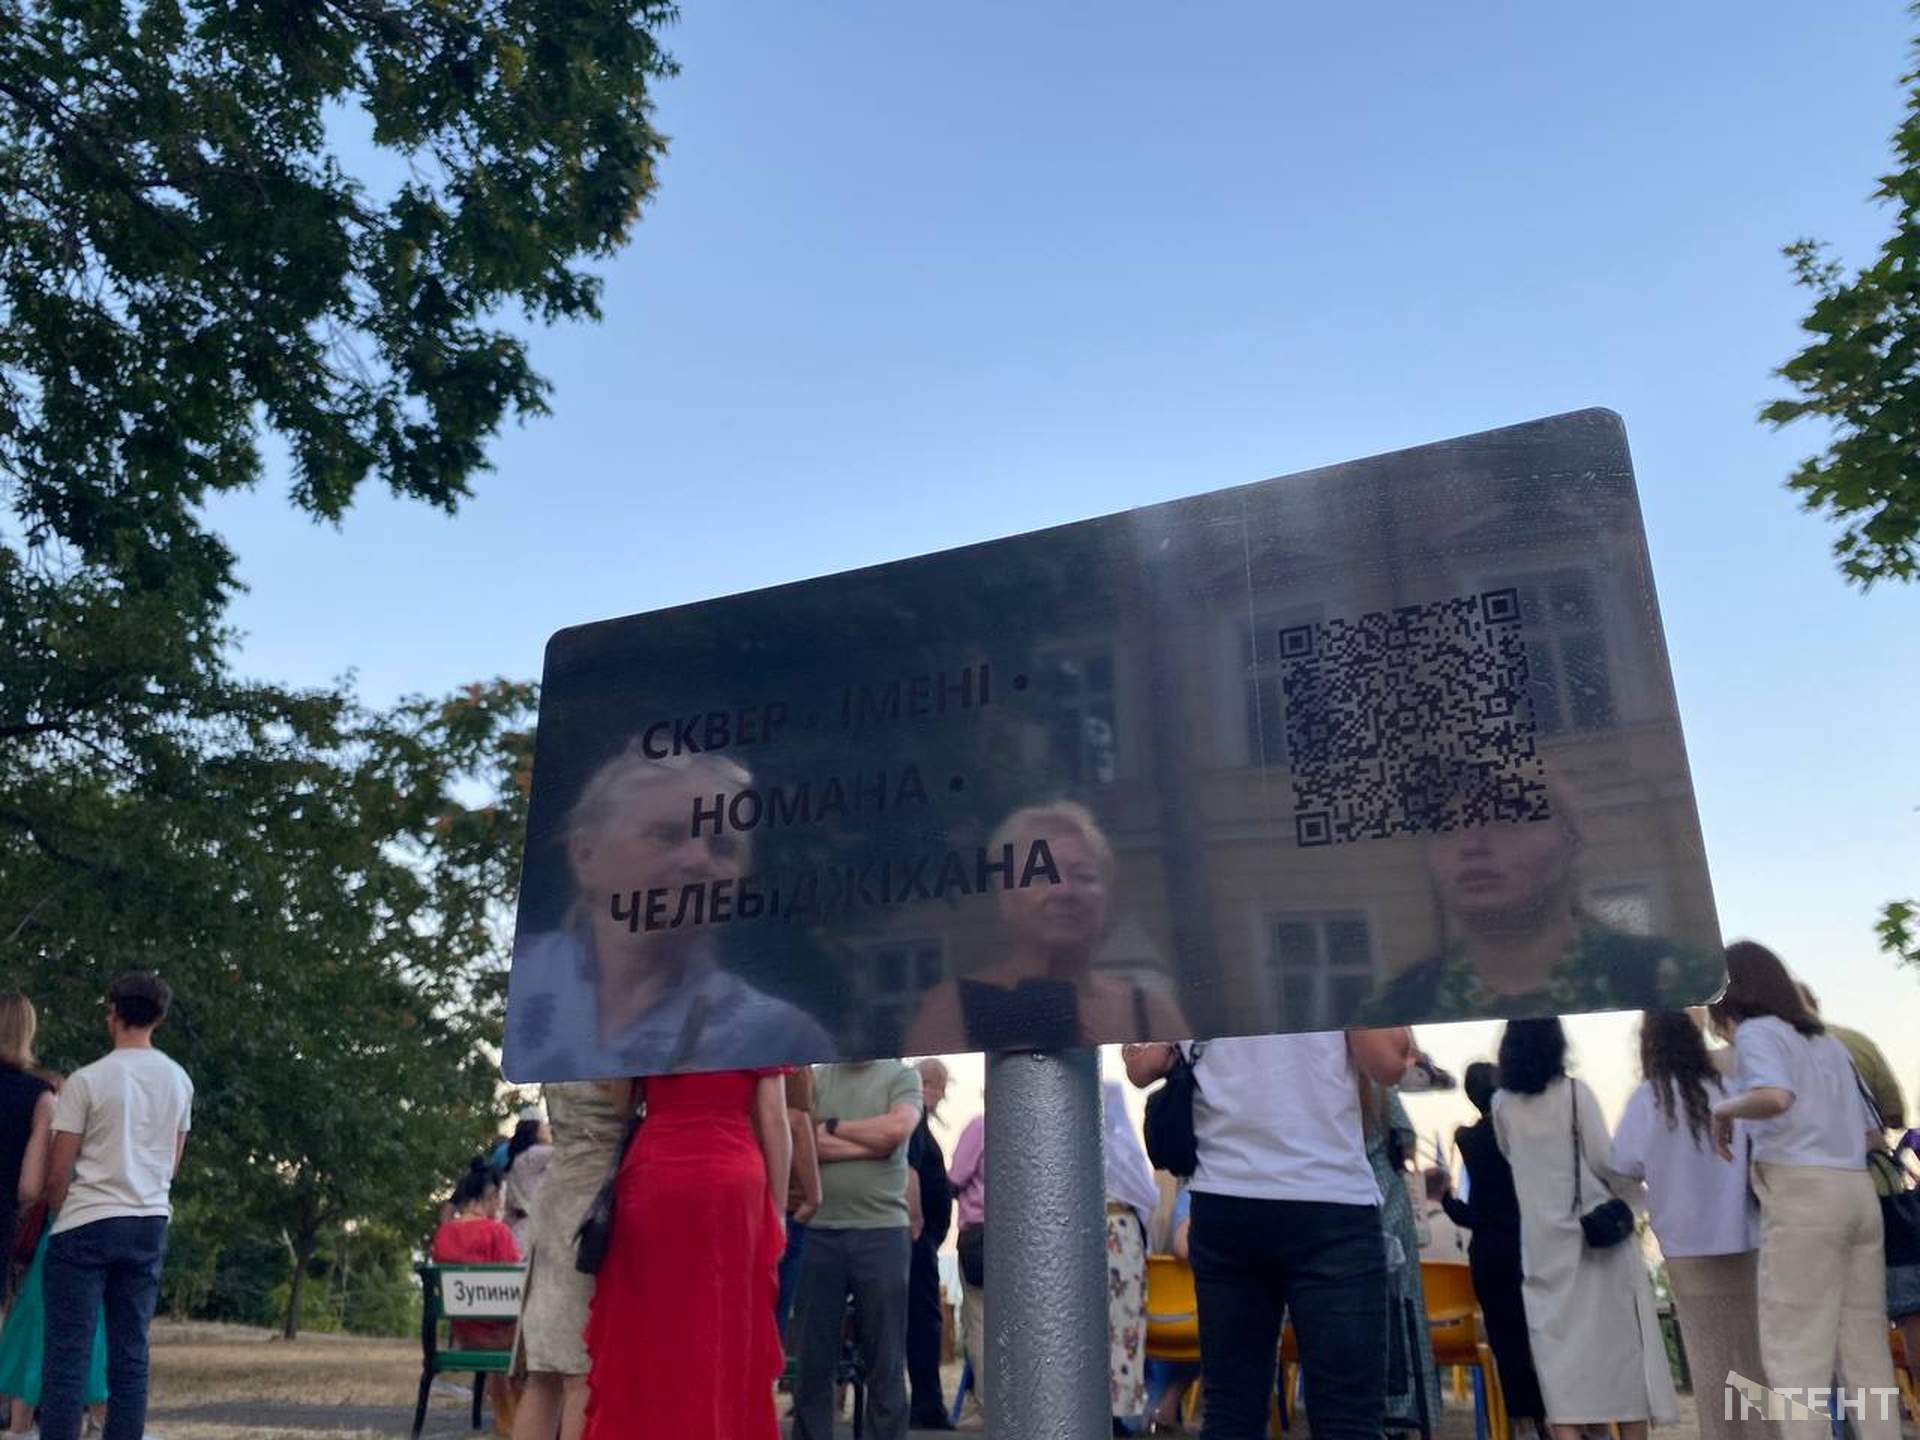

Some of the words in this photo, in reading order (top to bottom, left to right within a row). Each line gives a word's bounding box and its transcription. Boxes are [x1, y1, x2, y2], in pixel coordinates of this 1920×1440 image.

[643, 700, 788, 759] СКВЕР
[841, 664, 989, 728] ІМЕНІ
[691, 764, 929, 838] НОМАНА
